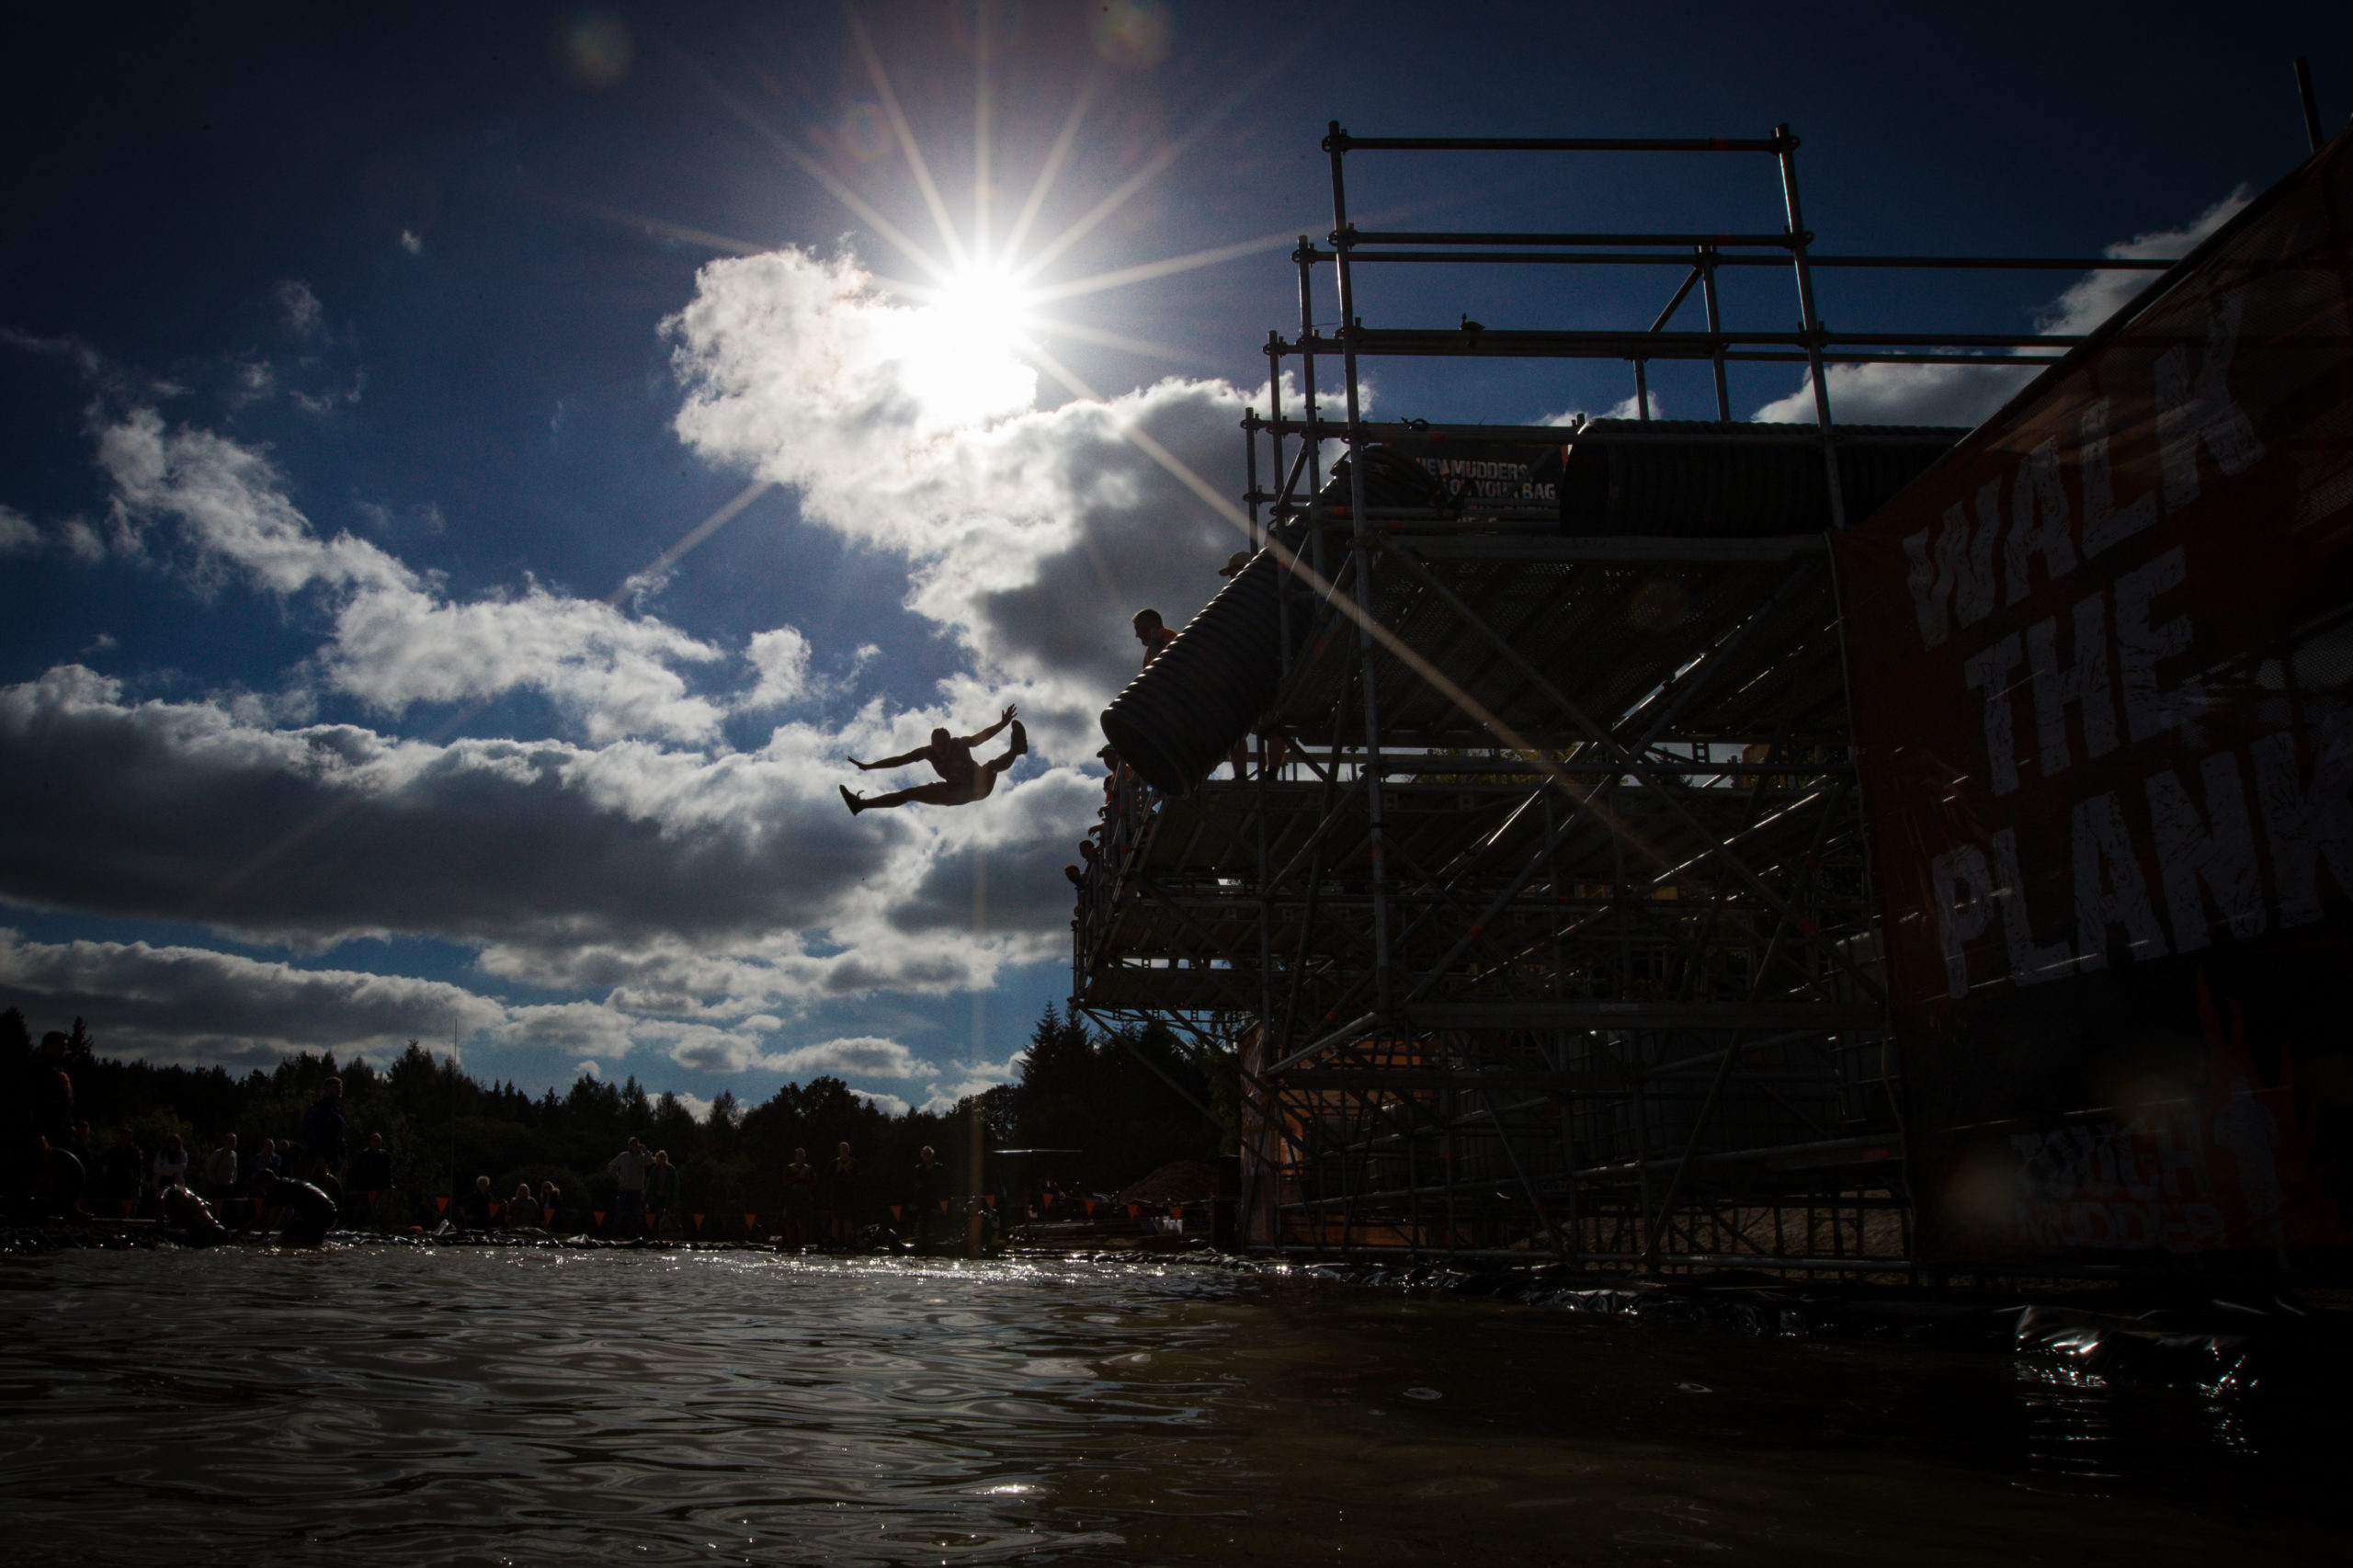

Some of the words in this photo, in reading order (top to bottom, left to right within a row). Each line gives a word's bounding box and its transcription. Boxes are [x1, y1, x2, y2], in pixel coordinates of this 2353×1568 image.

[1475, 480, 1519, 498] YOU
[1522, 483, 1557, 500] BAG
[1902, 287, 2268, 653] WALK
[1963, 544, 2210, 798] THE
[1931, 704, 2353, 1000] PLANK
[2010, 1109, 2206, 1199] TOUGH
[2015, 1199, 2228, 1253] MUDDER
